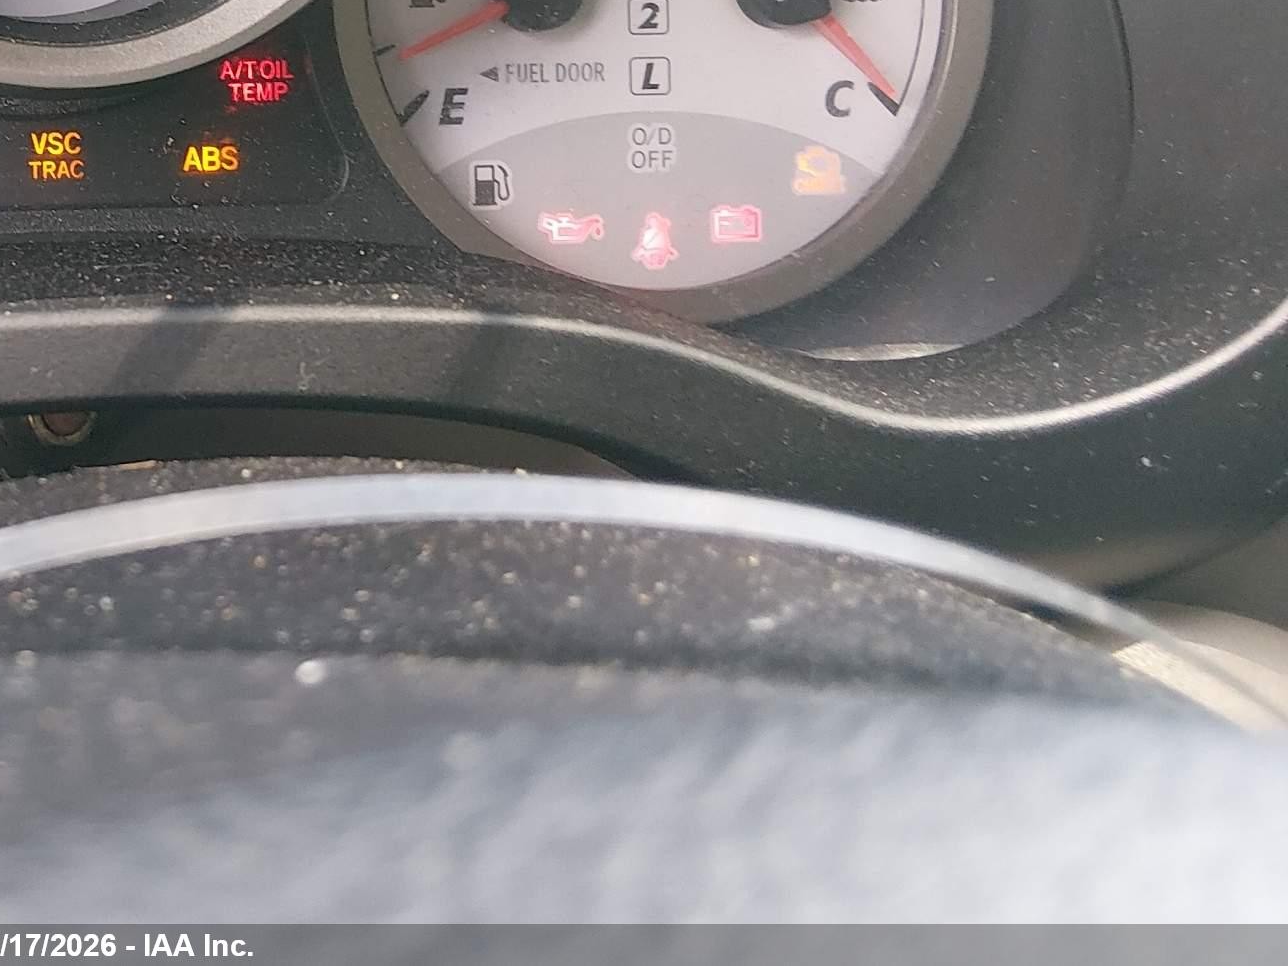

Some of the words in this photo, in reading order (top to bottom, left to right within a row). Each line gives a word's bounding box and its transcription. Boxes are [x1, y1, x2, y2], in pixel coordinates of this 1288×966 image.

[638, 3, 660, 29] 2
[259, 59, 294, 79] OIL
[505, 63, 549, 83] FUEL
[555, 62, 605, 82] DOOR
[641, 63, 660, 89] L
[228, 81, 288, 101] TEMP
[825, 79, 855, 117] C
[438, 87, 469, 125] E
[31, 131, 81, 154] VSC
[631, 126, 673, 145] O/D
[29, 159, 84, 178] TRAC
[183, 145, 240, 171] ABS
[631, 150, 673, 168] OFF
